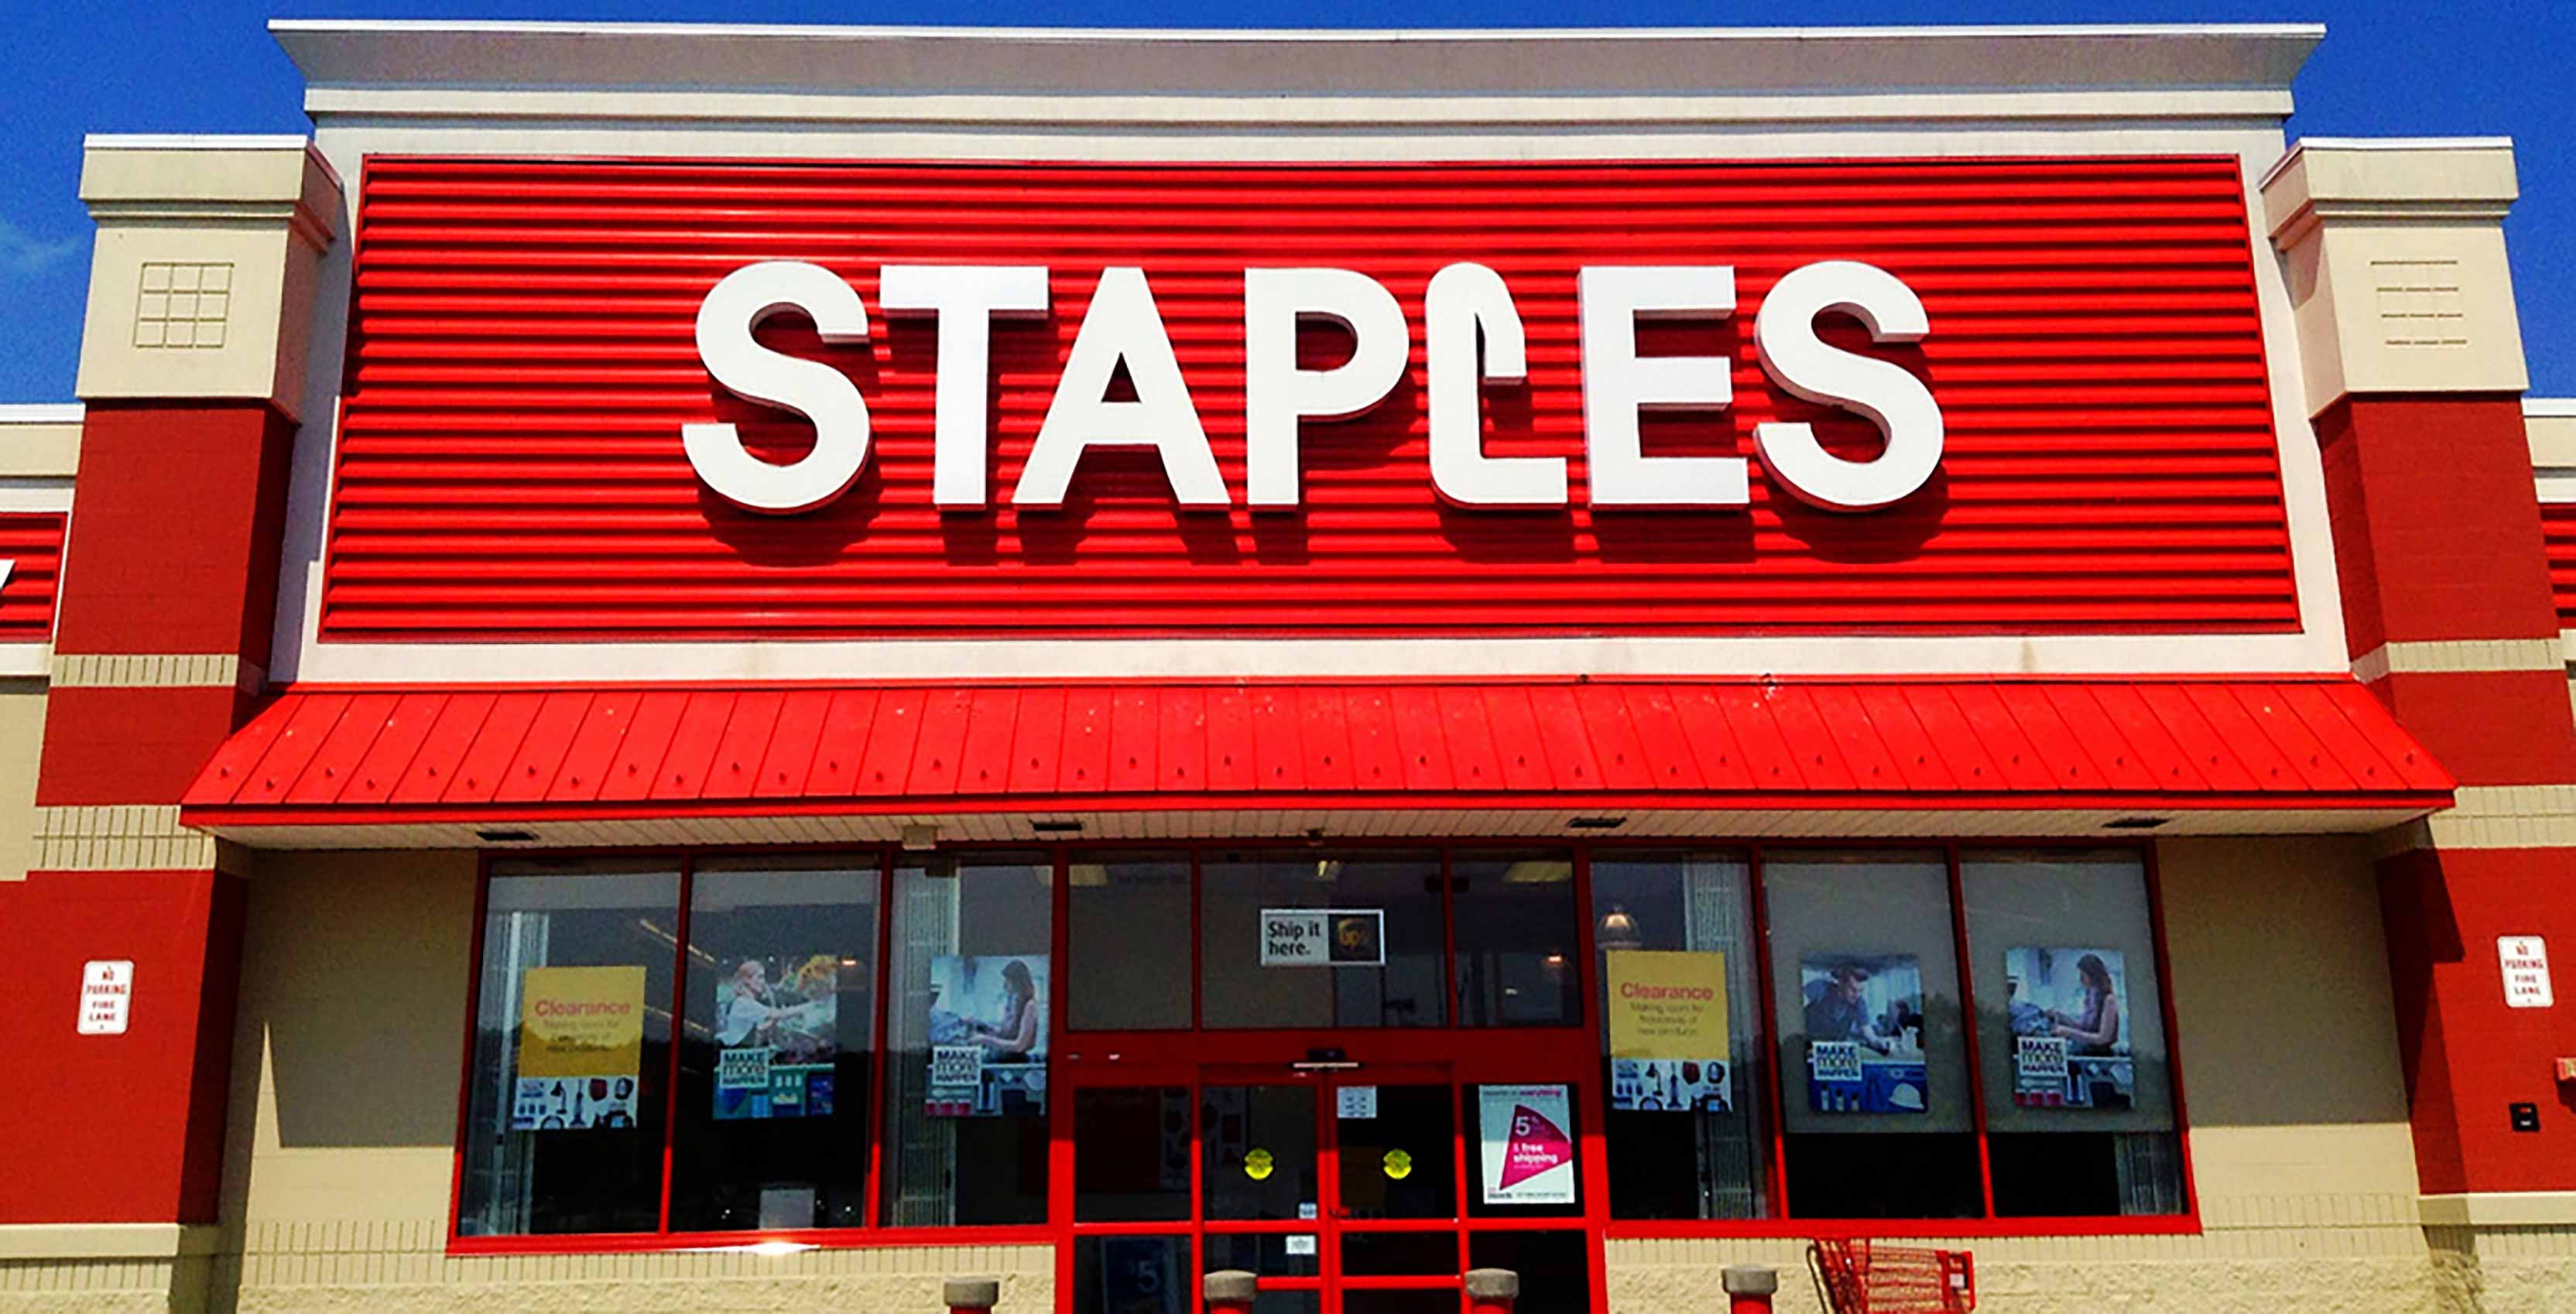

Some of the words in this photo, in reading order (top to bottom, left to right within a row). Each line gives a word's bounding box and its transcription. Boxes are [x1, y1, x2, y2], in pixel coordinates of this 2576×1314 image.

[681, 260, 1945, 512] STAPLES
[1268, 921, 1304, 940] Ship
[1307, 920, 1321, 937] it
[1268, 940, 1311, 956] here.
[2516, 945, 2529, 956] NO
[2505, 959, 2543, 970] PARKING
[102, 970, 115, 980] NO
[2514, 975, 2537, 984] FIRE
[87, 984, 126, 995] PARKING
[1620, 981, 1714, 1001] Clearance
[2514, 987, 2541, 995] LANE
[92, 1001, 115, 1009] FIRE
[534, 998, 632, 1016] Clearance
[89, 1012, 115, 1021] LANE
[1816, 1045, 1855, 1055] MAKE
[2021, 1041, 2063, 1052] MAKE
[724, 1052, 766, 1062] MAKE
[937, 1049, 980, 1059] MAKE
[1521, 1142, 1544, 1151] free
[1512, 1153, 1559, 1165] shipping
